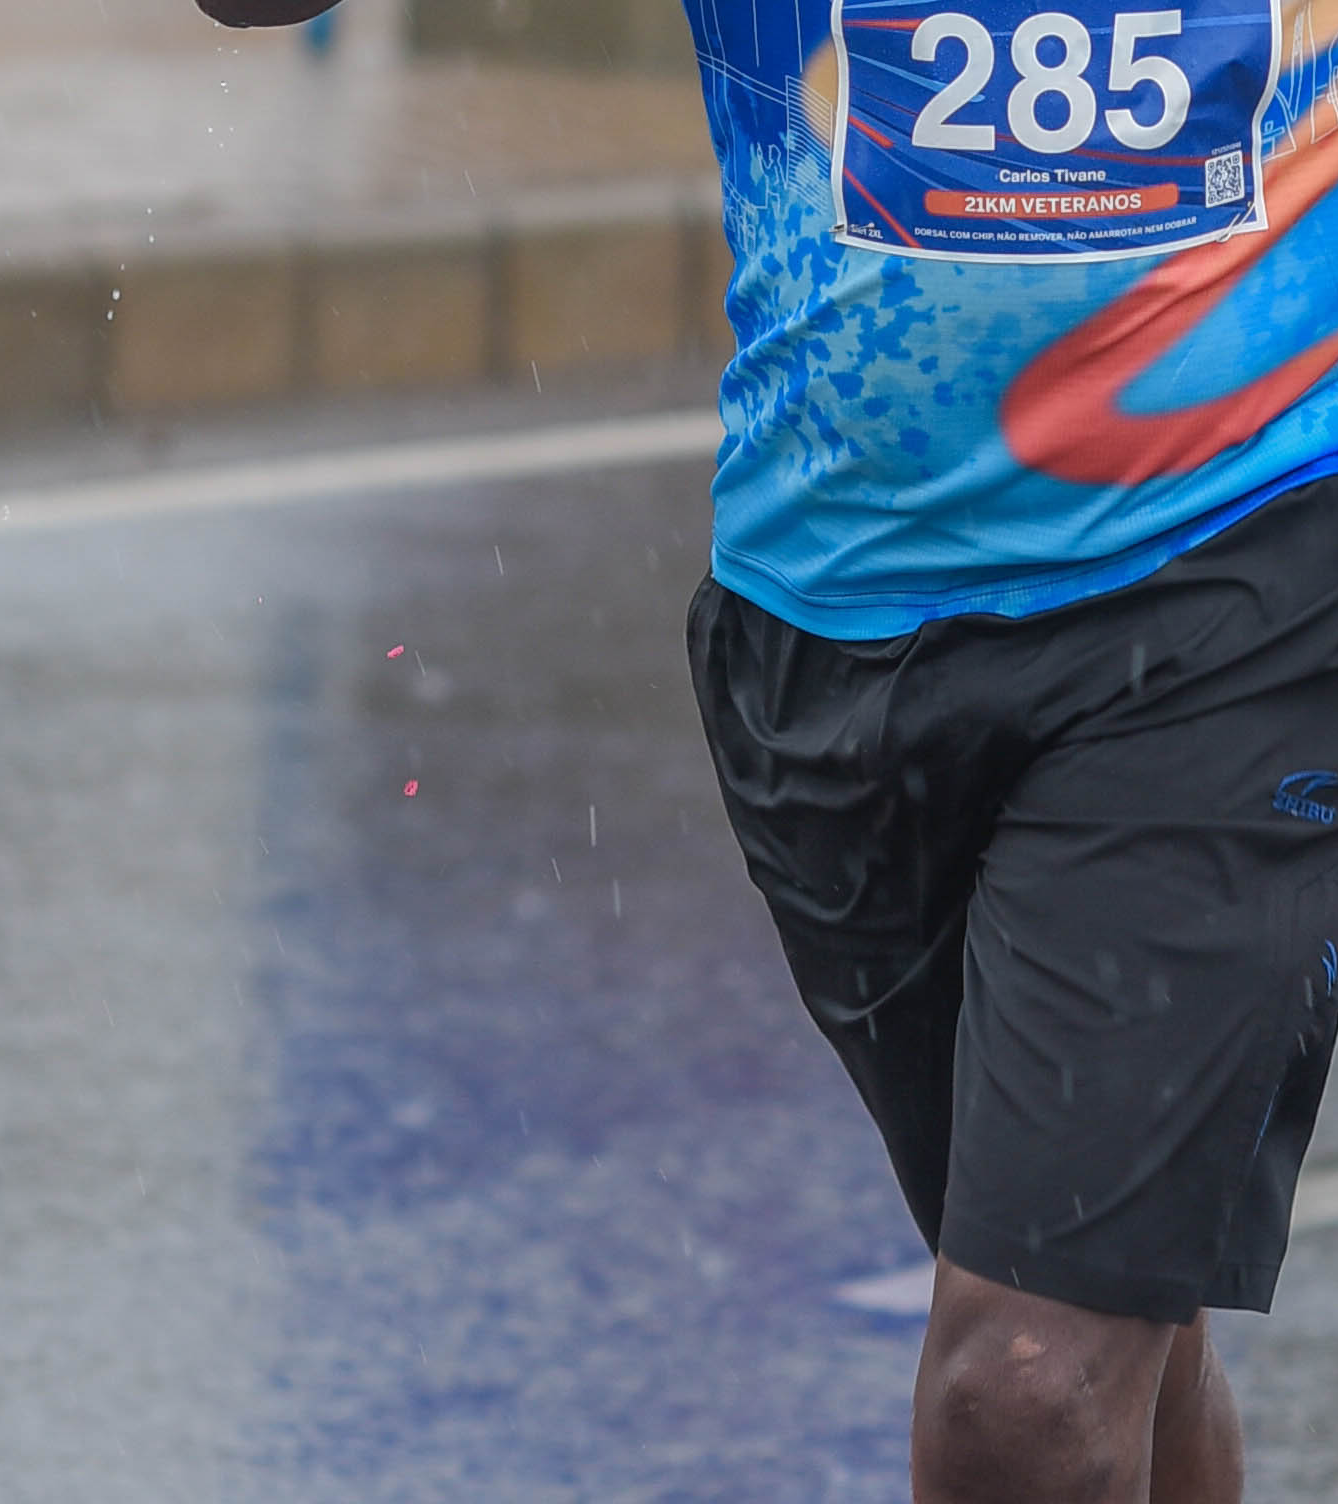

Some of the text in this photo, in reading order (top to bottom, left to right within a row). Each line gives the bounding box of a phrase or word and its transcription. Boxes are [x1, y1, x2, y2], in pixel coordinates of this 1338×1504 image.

[911, 10, 1191, 153] 285
[999, 169, 1106, 183] Carlos Tivane
[964, 193, 1142, 214] 21KM VETERANOS
[914, 227, 949, 238] DORSAL
[949, 231, 971, 240] COM
[996, 231, 1017, 241] NÃO
[1067, 230, 1086, 240] NÃO
[1088, 226, 1143, 240] AMARROTAR
[1144, 223, 1163, 234] NEM
[1164, 216, 1197, 231] DOBRAR
